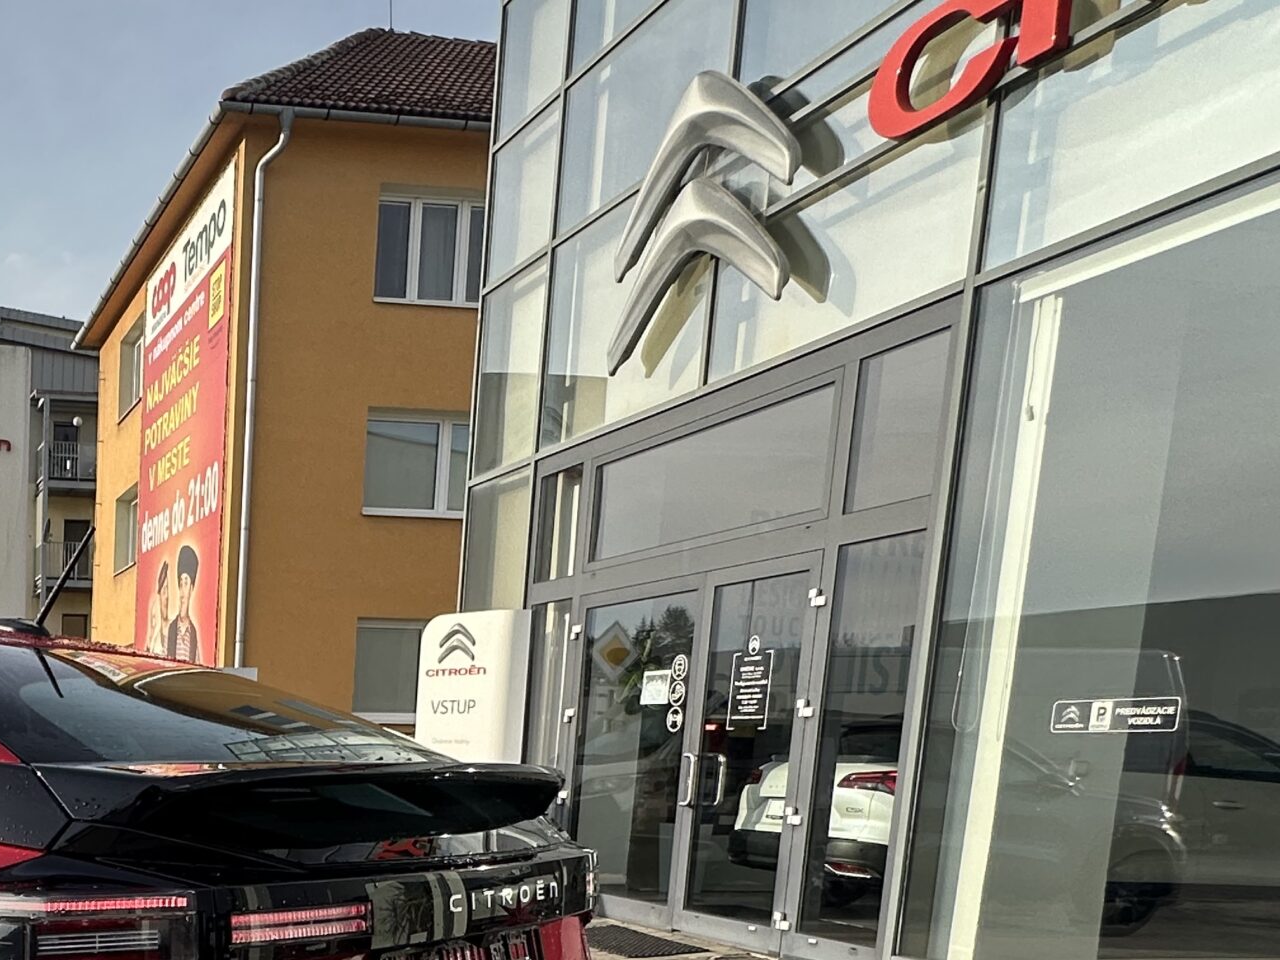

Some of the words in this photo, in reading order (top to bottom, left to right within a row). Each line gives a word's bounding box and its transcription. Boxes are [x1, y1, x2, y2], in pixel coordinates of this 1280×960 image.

[182, 198, 227, 282] Tempo
[144, 381, 200, 455] POTRAVINY
[149, 466, 156, 492] V
[157, 435, 191, 488] MESTE
[141, 507, 170, 553] denne
[171, 489, 185, 537] do
[187, 460, 219, 528] 21:00
[431, 699, 476, 715] VSTUP
[1096, 706, 1107, 722] P
